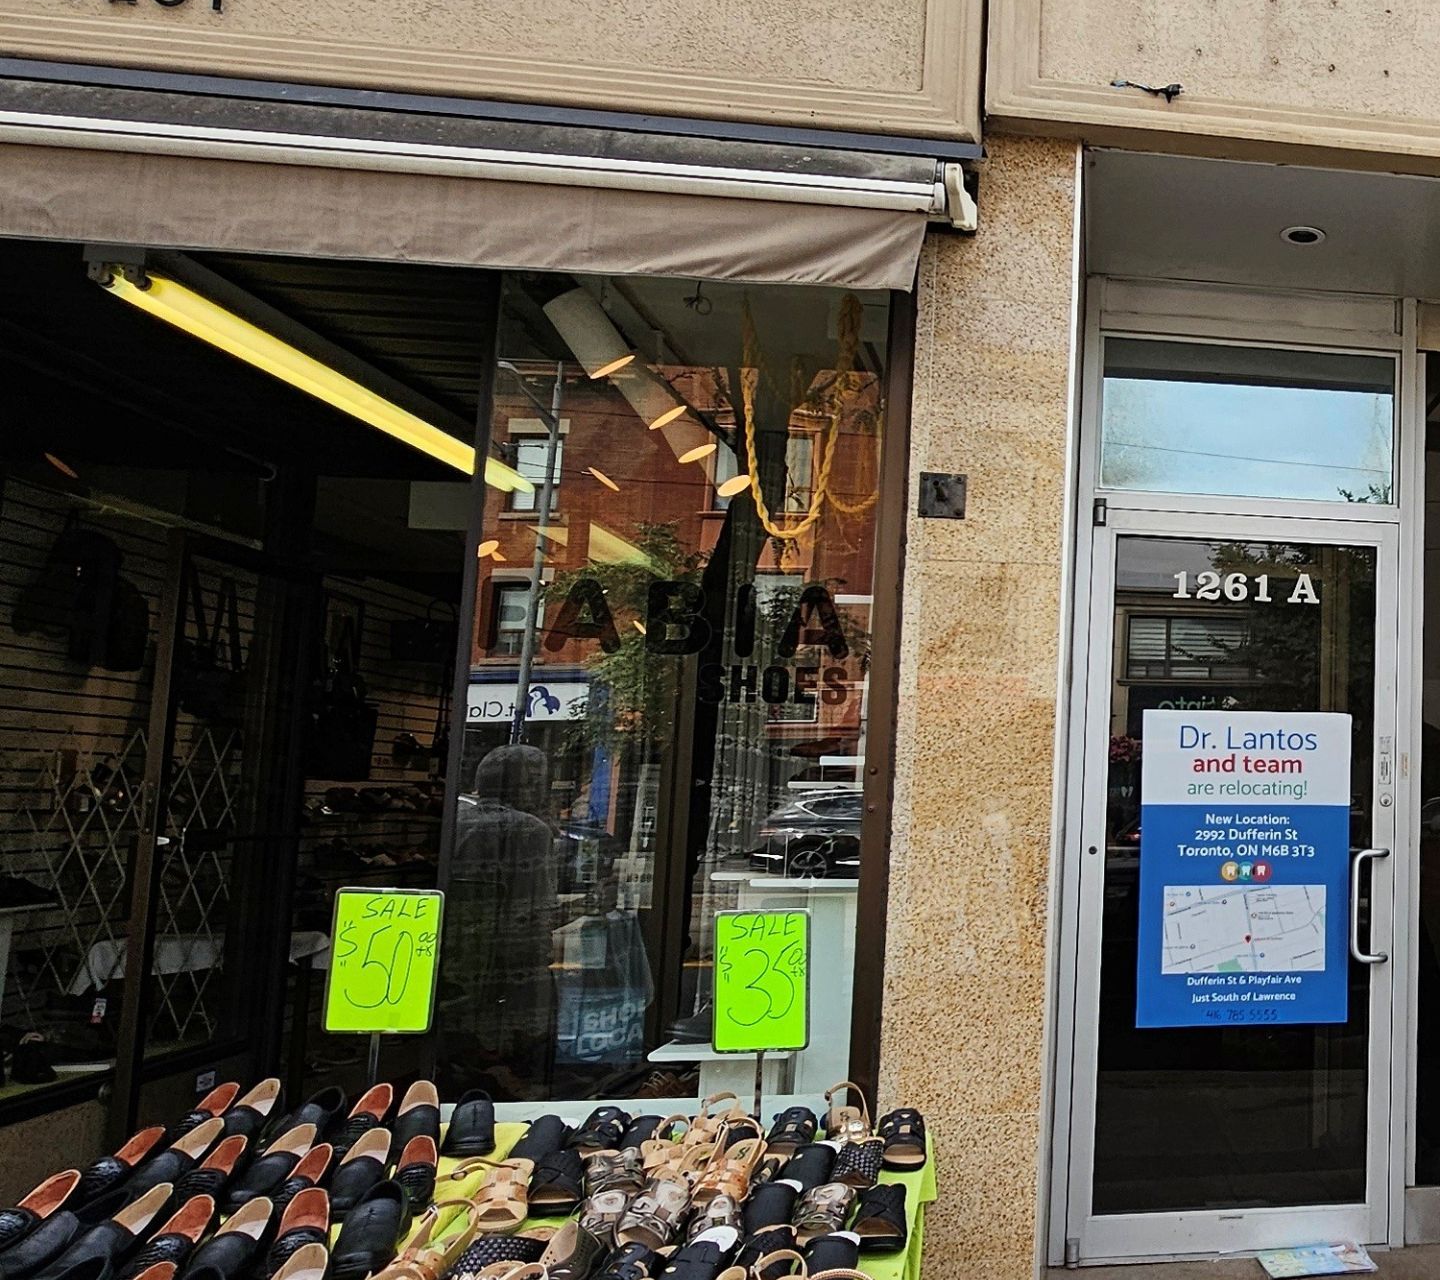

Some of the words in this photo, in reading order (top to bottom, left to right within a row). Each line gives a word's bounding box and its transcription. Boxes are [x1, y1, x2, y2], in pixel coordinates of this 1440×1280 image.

[1172, 570, 1273, 603] 1261
[1287, 573, 1320, 605] A
[700, 664, 849, 706] SHOES
[1179, 725, 1217, 750] Dr.
[1227, 726, 1318, 751] Lantos
[1193, 754, 1236, 773] and
[1244, 755, 1303, 773] team
[1187, 782, 1214, 796] are
[1219, 780, 1308, 800] relocating!
[1205, 814, 1233, 825] New
[1236, 814, 1290, 825] Location:
[1195, 829, 1226, 840] 2992
[1229, 828, 1282, 840] Dufferin
[1285, 829, 1298, 841] St
[1177, 844, 1234, 858] Toronto,
[1237, 845, 1258, 856] ON
[1261, 845, 1289, 856] M6B
[1291, 846, 1315, 858] 3T3
[361, 897, 429, 920] SALE
[730, 912, 797, 941] SALE
[1186, 975, 1225, 986] Dufferin
[1227, 975, 1238, 985] St
[1239, 975, 1246, 985] &
[1248, 975, 1284, 987] Playfair
[1285, 975, 1302, 984] Ave
[1192, 993, 1210, 1004] Just
[1212, 993, 1239, 1003] South
[1241, 992, 1251, 1001] of
[1253, 992, 1297, 1002] Lawrence
